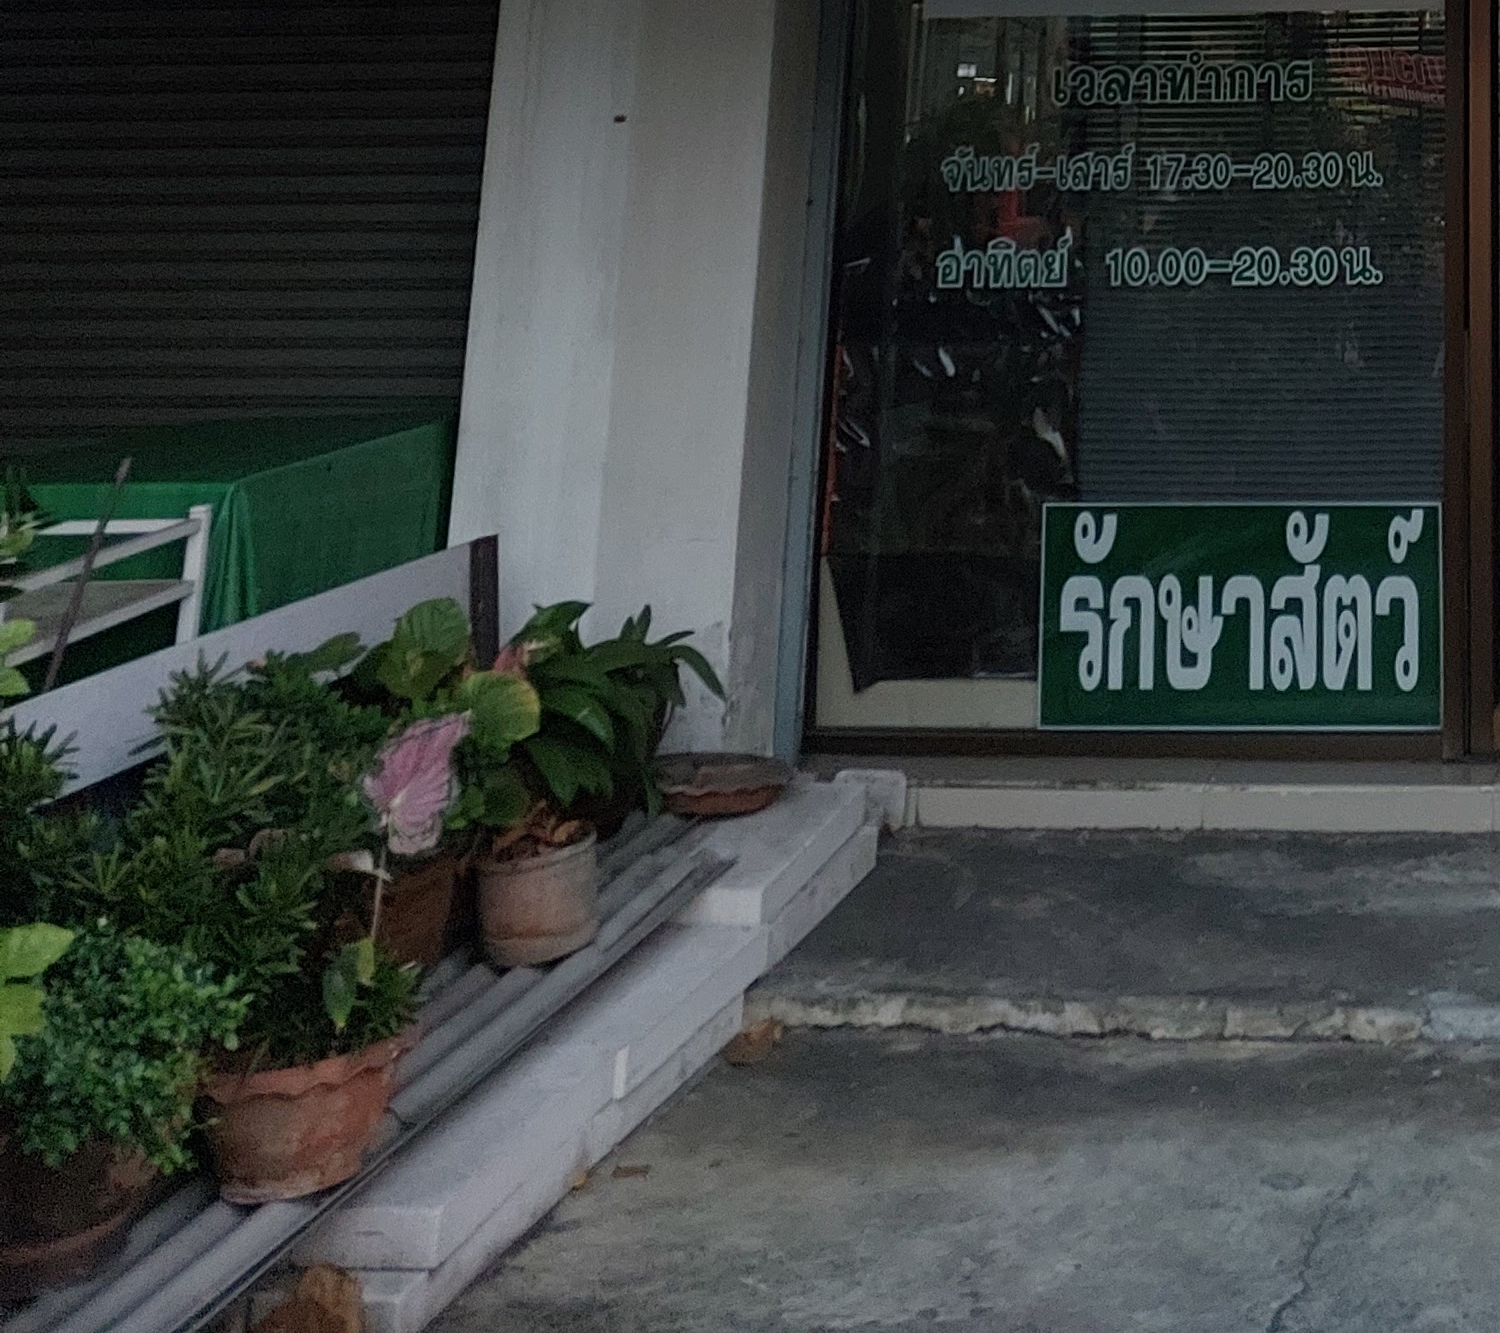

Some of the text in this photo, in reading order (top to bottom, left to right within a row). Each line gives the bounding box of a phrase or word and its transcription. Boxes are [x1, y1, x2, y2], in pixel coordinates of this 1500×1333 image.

[1051, 51, 1314, 106] เวลาทำการ
[941, 143, 1136, 193] จันทร์-เสาร์
[1059, 508, 1425, 692] รักษาสัตว์
